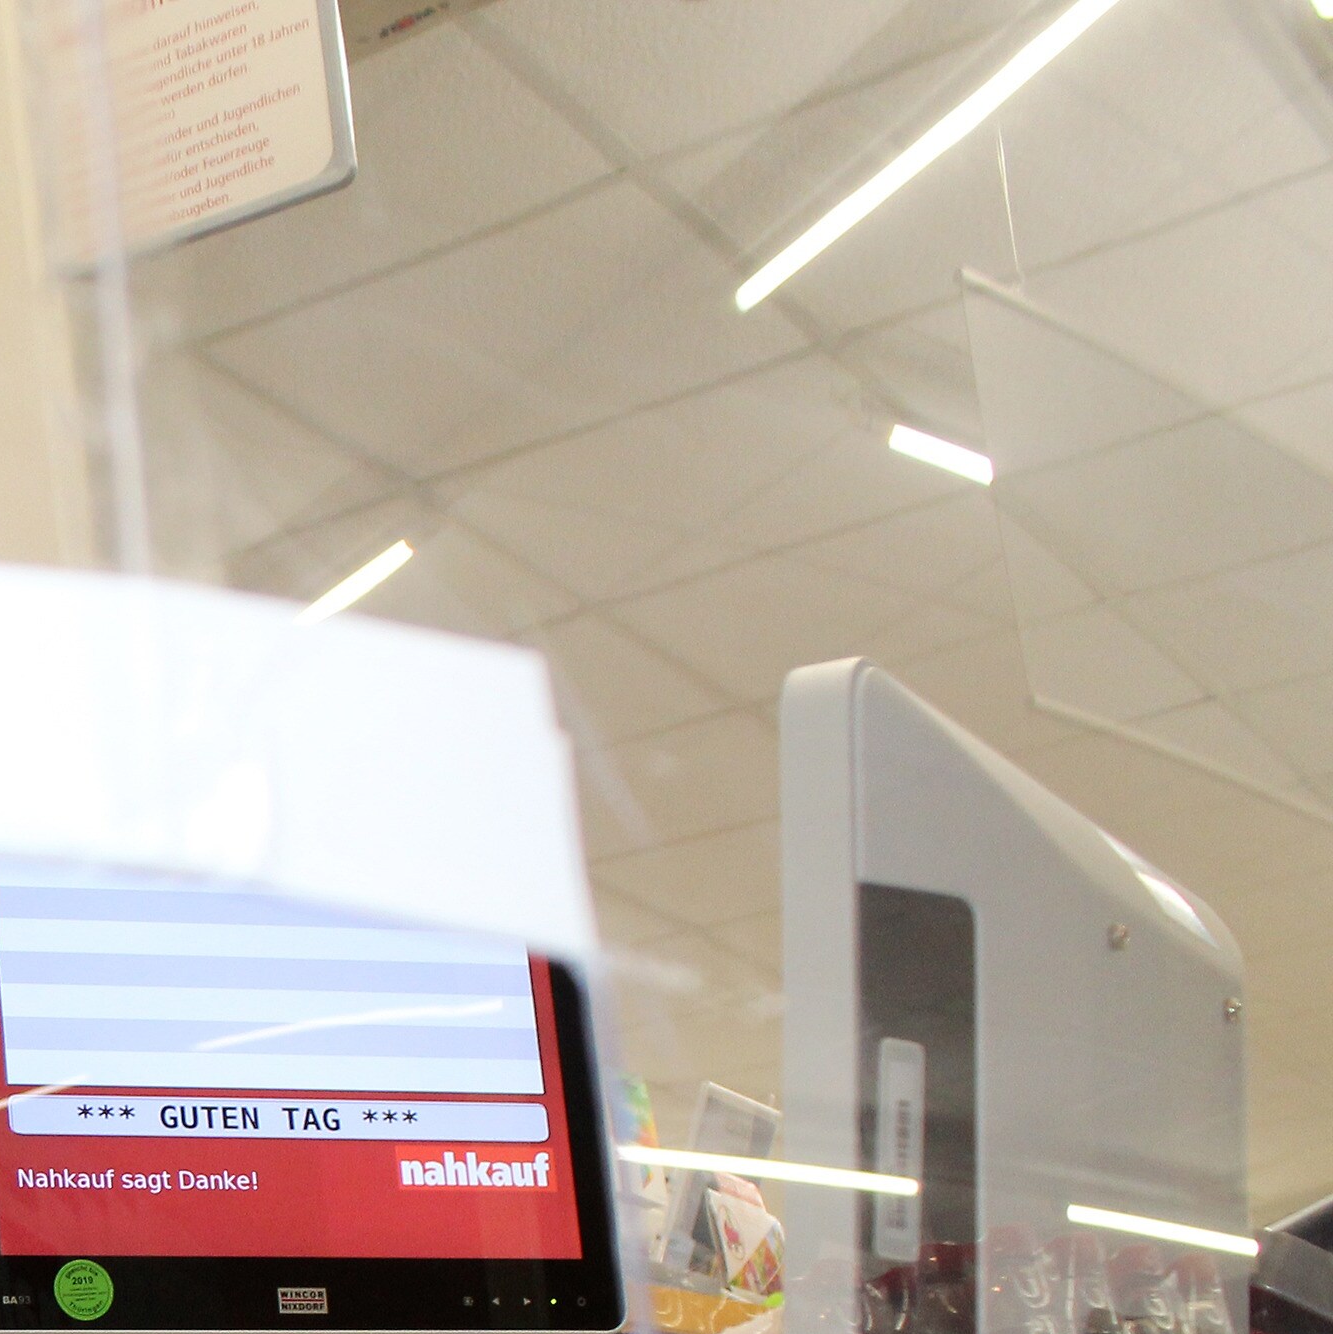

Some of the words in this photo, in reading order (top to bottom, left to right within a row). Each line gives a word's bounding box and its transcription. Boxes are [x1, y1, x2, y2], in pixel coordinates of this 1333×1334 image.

[155, 27, 192, 51] darauf
[176, 23, 247, 60] Tabakwaren
[216, 43, 247, 64] unter
[251, 33, 266, 49] 18
[269, 18, 310, 43] Jahren
[196, 113, 219, 132] und
[223, 83, 301, 122] Jugendlichen
[186, 121, 260, 156] entschieden,
[202, 136, 270, 170] Feuerzeuge
[180, 181, 202, 199] und
[205, 155, 275, 191] Jugendliche
[160, 1105, 259, 1131] GUTEN
[282, 1108, 342, 1132] TAG
[17, 1168, 115, 1190] Nahkauf
[121, 1170, 171, 1194] sagt
[178, 1168, 258, 1191] Danke!
[400, 1152, 551, 1188] nahkauf
[72, 1275, 94, 1285] 2019
[280, 1290, 324, 1299] WINCOR
[2, 1295, 31, 1305] BA93
[281, 1302, 326, 1311] NIXDORF
